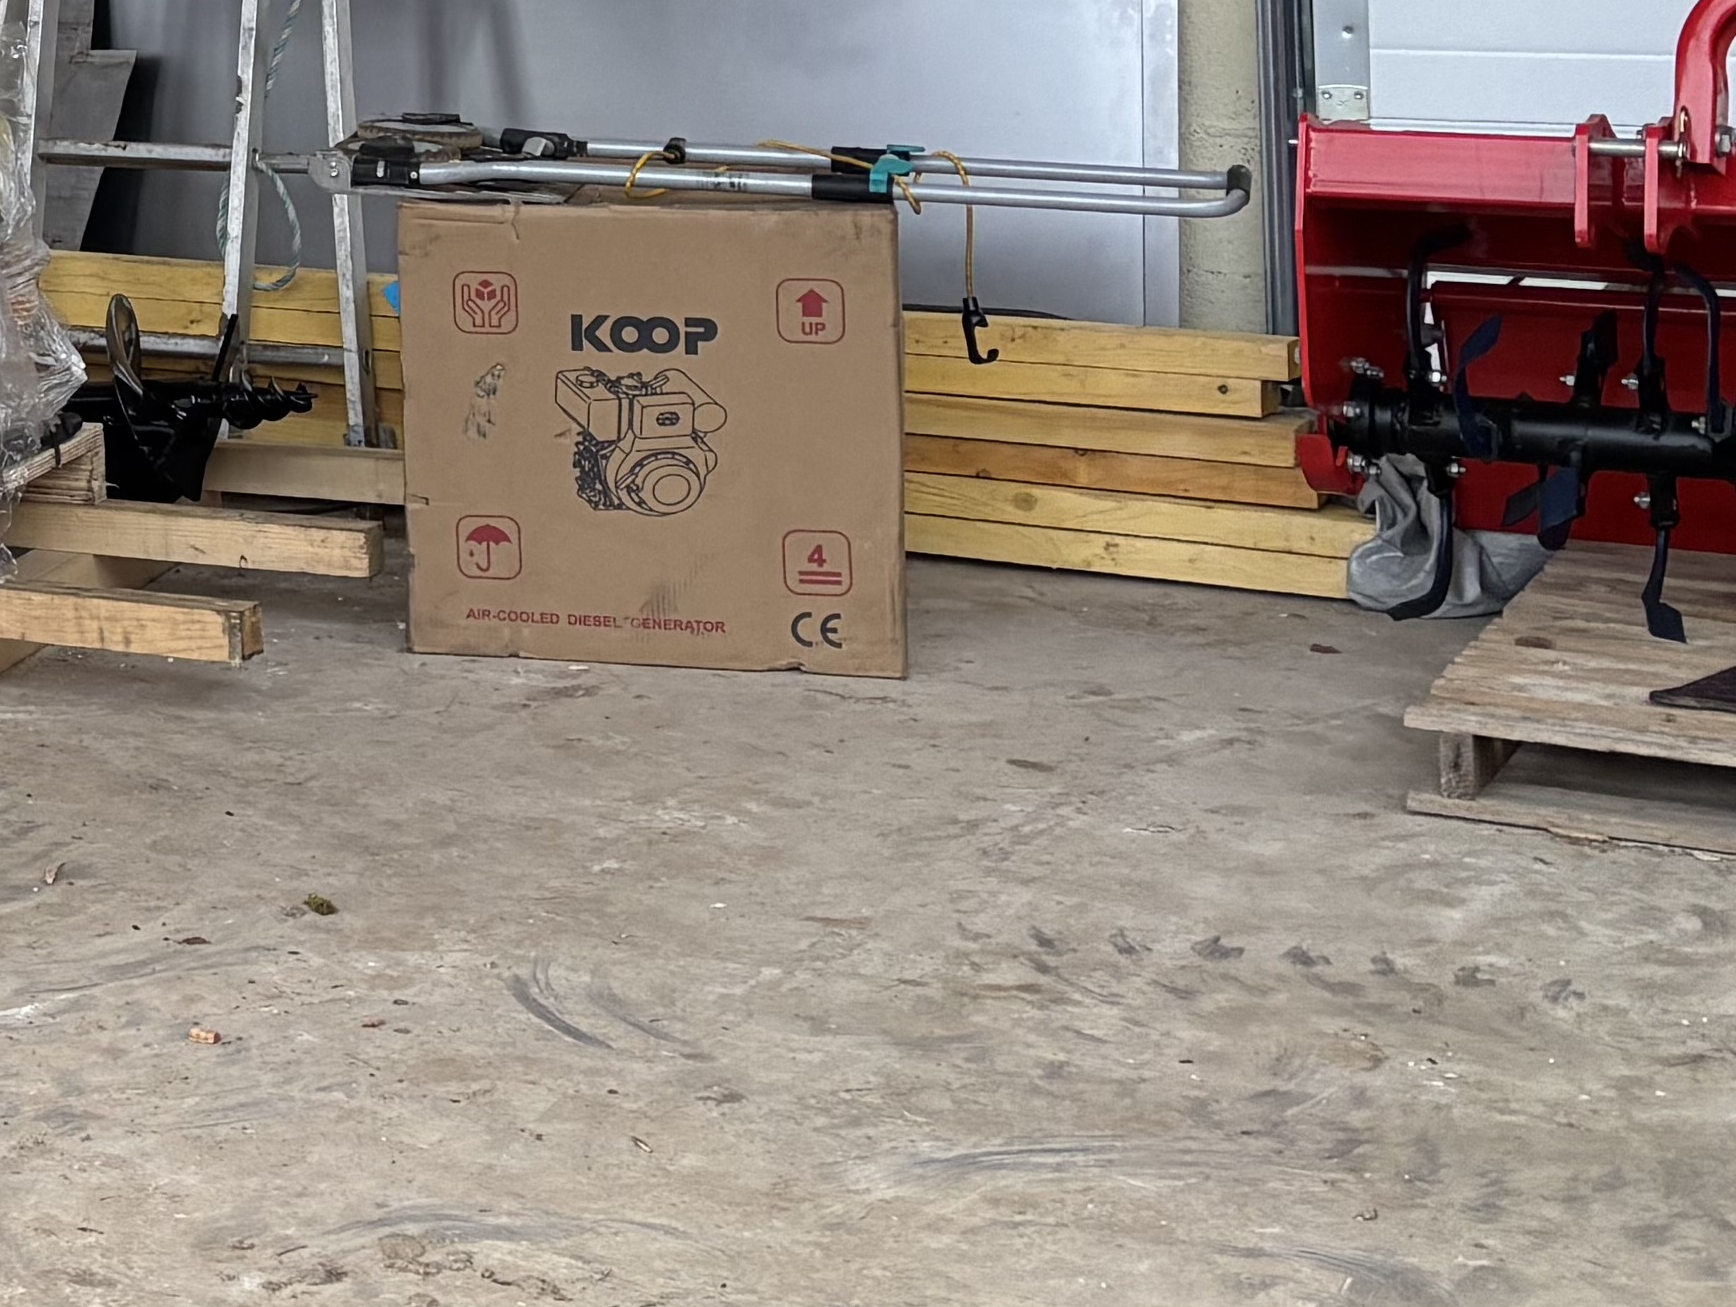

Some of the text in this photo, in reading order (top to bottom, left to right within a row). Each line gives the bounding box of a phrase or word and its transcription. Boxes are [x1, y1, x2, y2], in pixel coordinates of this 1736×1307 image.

[570, 314, 718, 355] KOOP
[800, 321, 826, 336] UP
[807, 544, 827, 568] 4
[466, 608, 727, 634] AIR-COOLED DIESEL GENERATOR
[791, 612, 843, 649] CE
